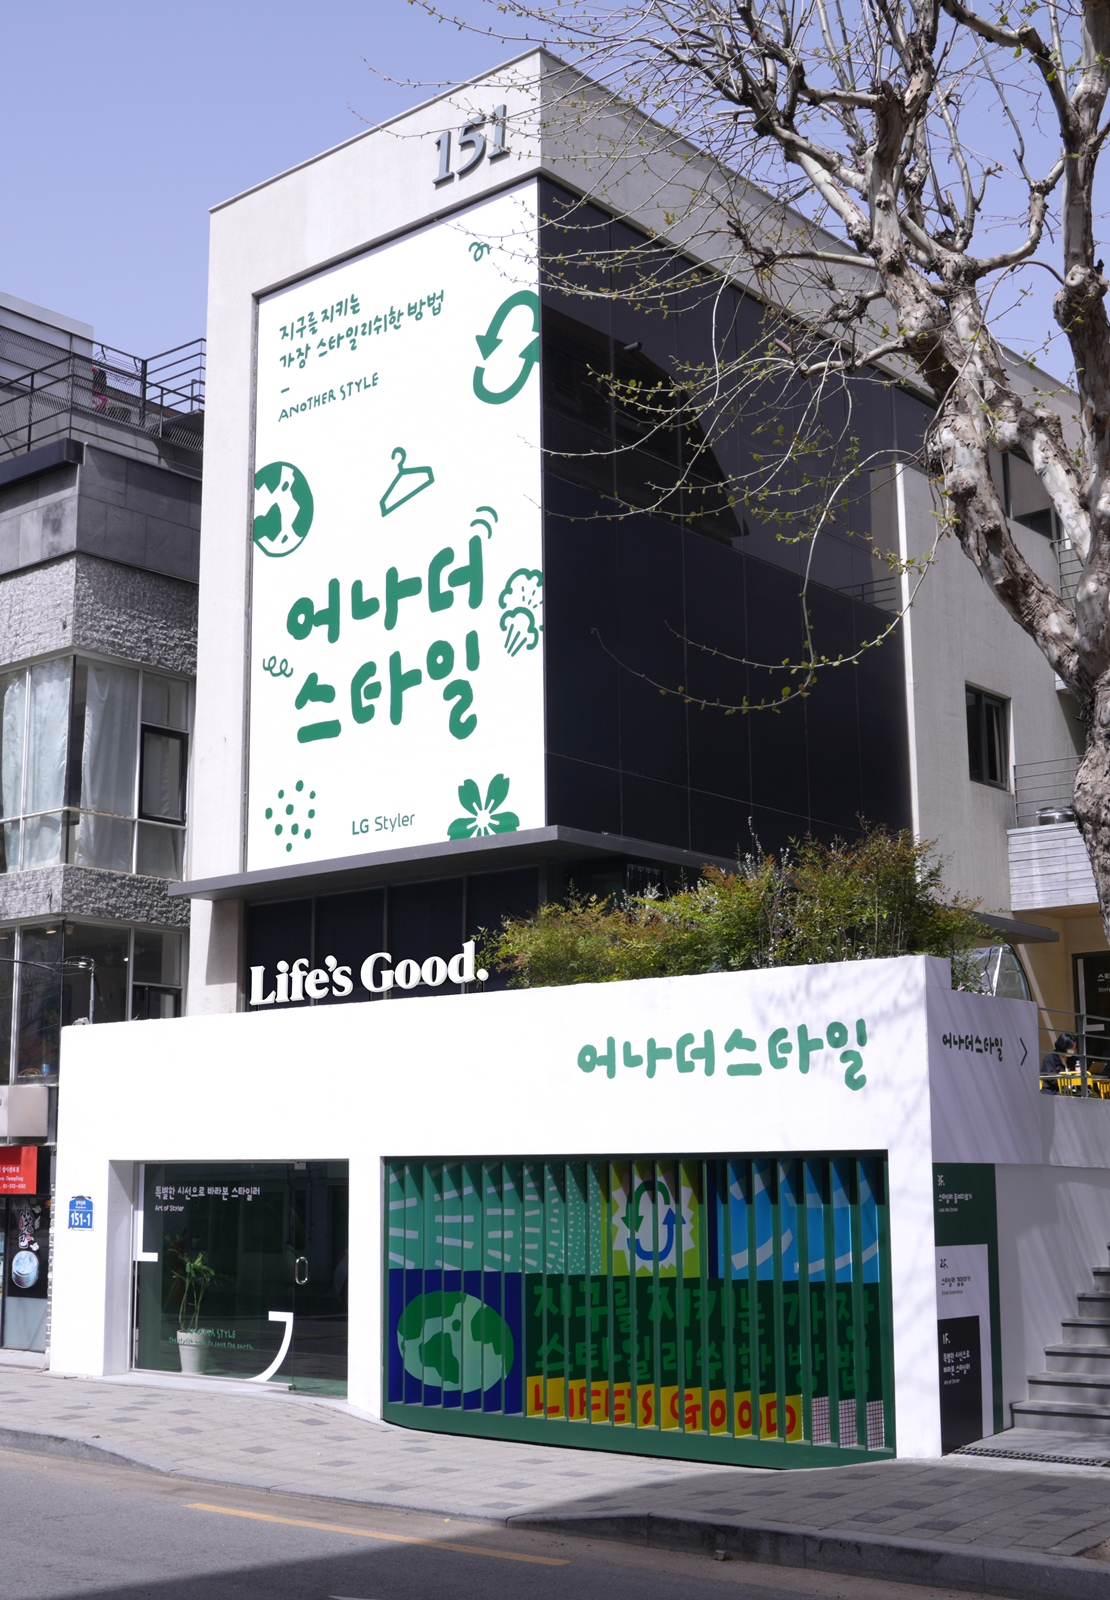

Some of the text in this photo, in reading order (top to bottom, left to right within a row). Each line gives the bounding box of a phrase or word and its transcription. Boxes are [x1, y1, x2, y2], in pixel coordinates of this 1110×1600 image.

[432, 104, 511, 187] 151
[279, 294, 361, 341] 지구를 지키는
[279, 290, 445, 369] 가장 스타일리쉬한 방법
[278, 372, 379, 422] ANOTHER STYLE
[286, 534, 484, 644] 어나더
[295, 630, 480, 744] 스타일
[352, 813, 416, 836] LG Styler
[249, 940, 490, 1006] Life's Good.
[577, 1018, 868, 1091] 어나더스타일
[942, 1032, 1003, 1062] 어나더스타일
[155, 1186, 261, 1201] 특별한 시선으로 바라본 스타일러
[70, 1213, 91, 1226] 151-1
[216, 1328, 236, 1339] STYLE
[533, 1280, 639, 1336] 지구를
[646, 1284, 766, 1337] 지키는
[669, 1393, 797, 1435] GOOD
